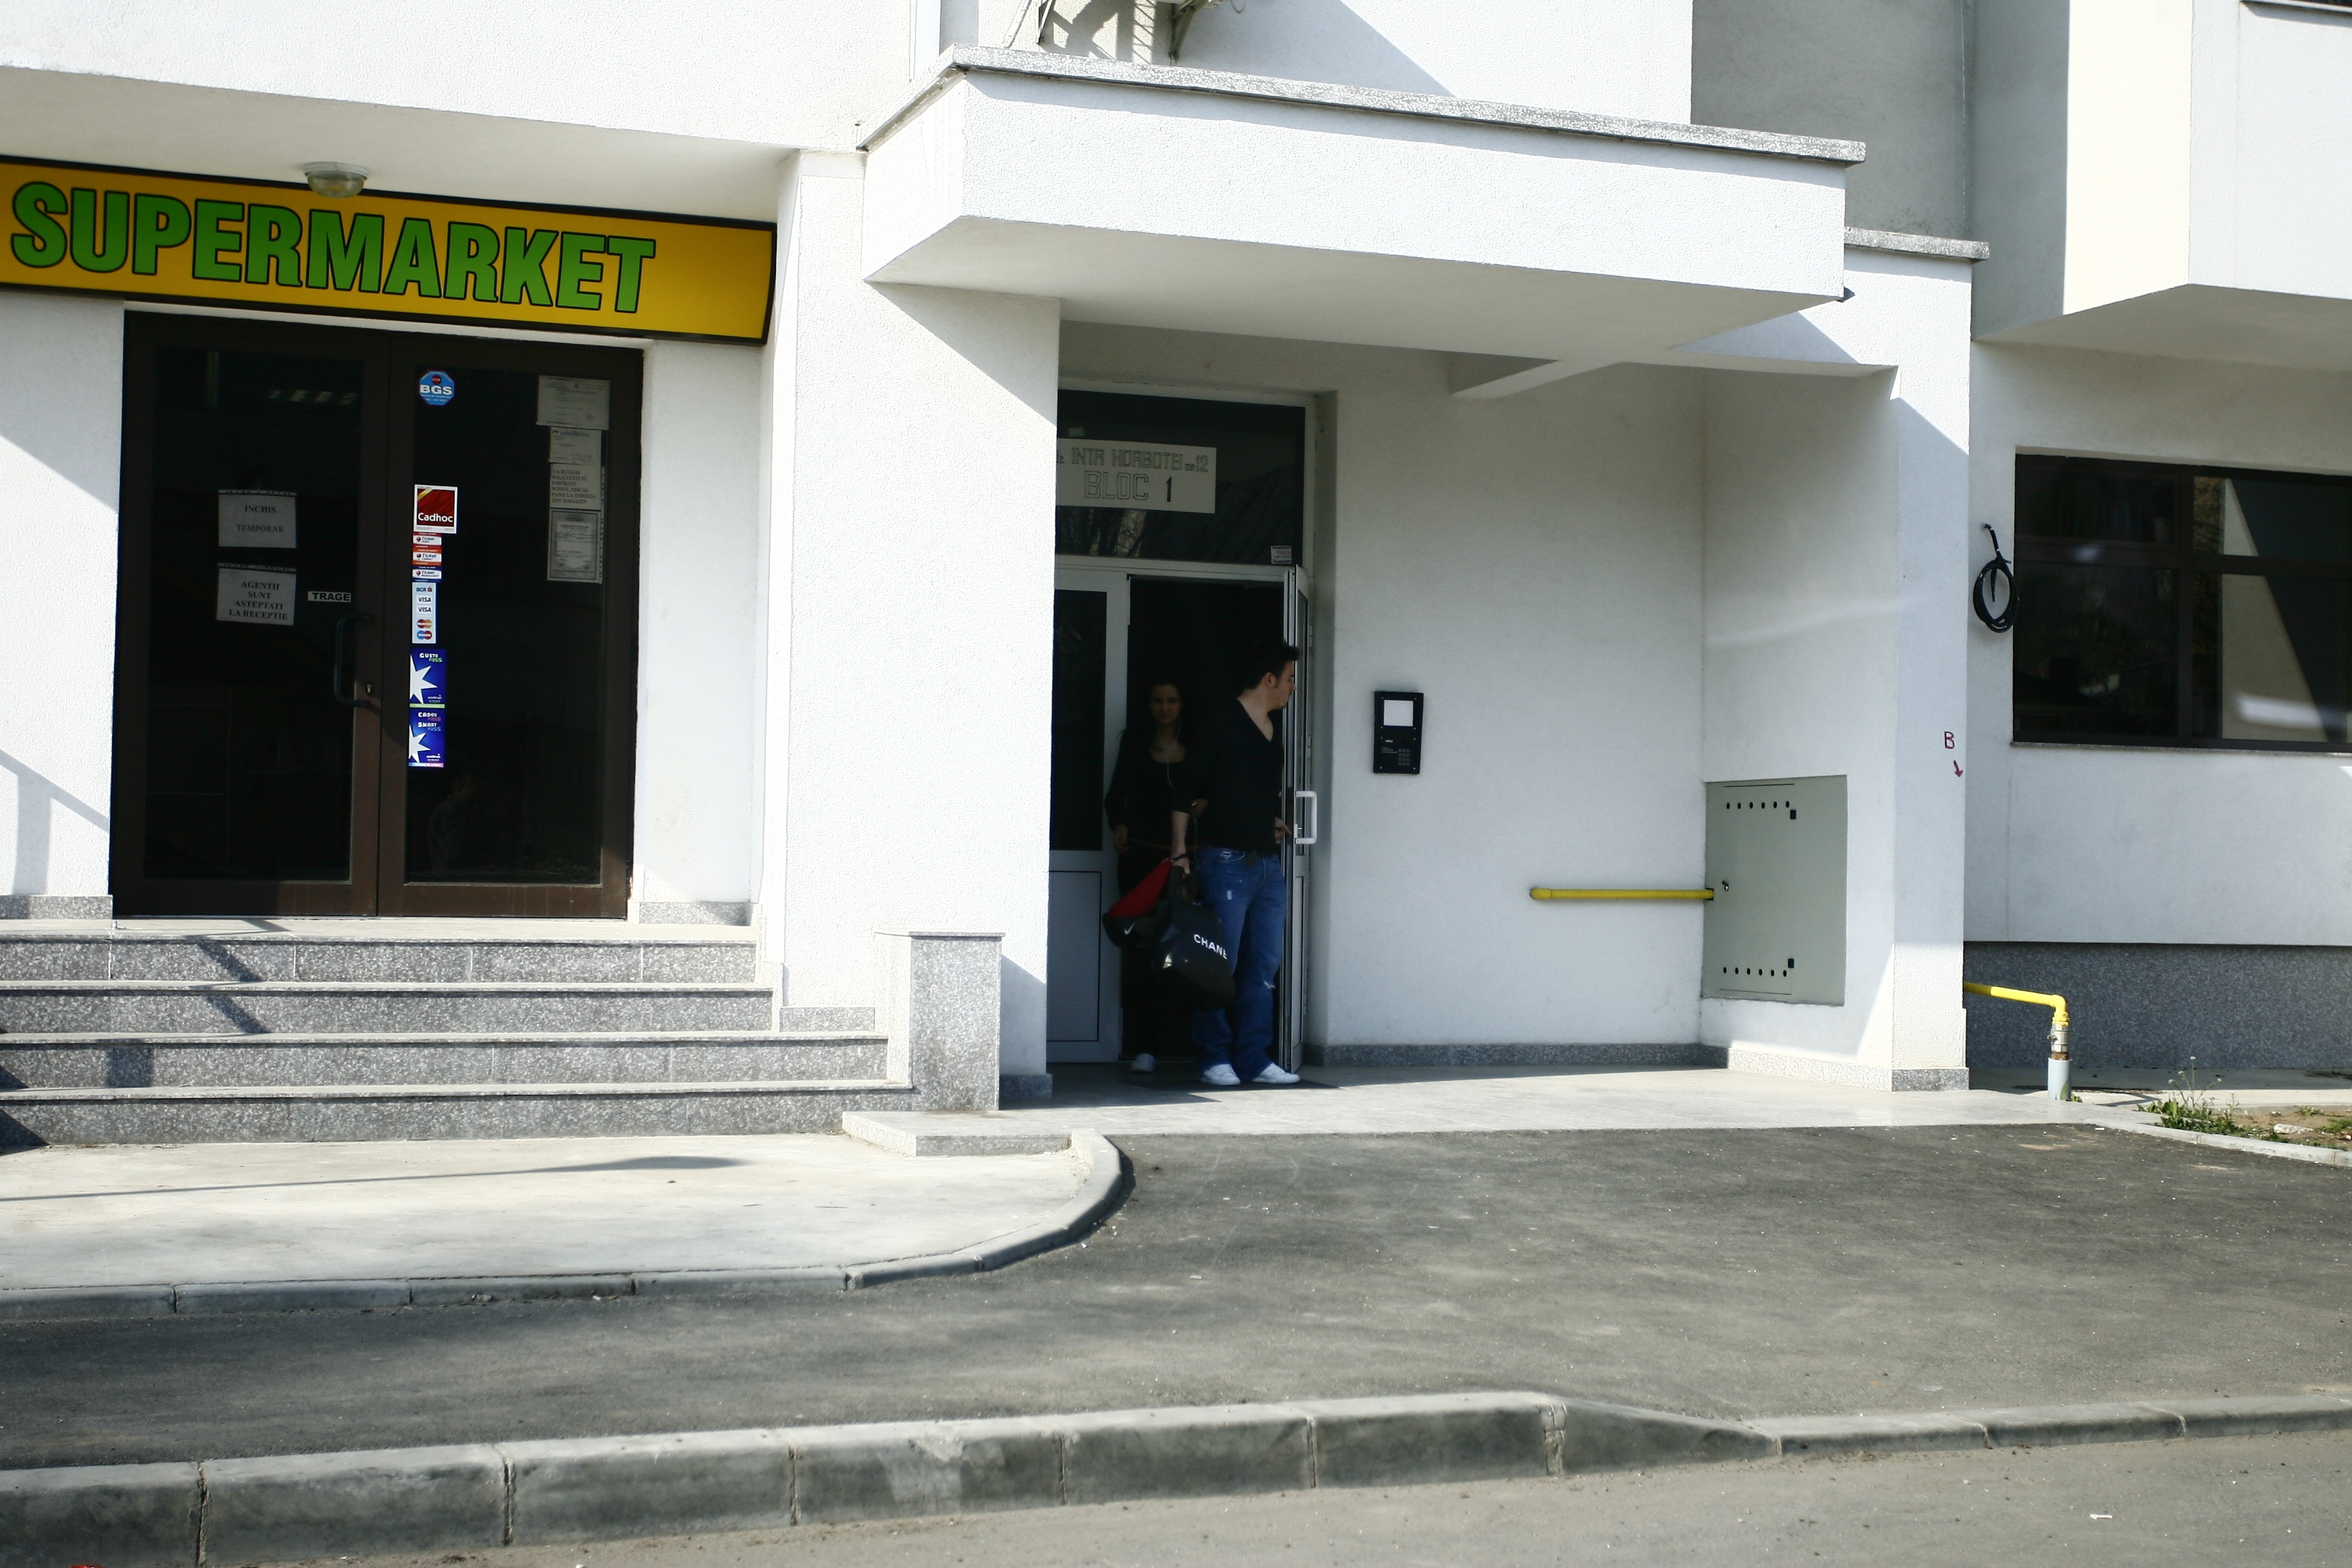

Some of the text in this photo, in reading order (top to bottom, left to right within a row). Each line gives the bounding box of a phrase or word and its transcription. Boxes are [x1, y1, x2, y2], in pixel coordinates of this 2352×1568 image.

[11, 181, 656, 314] SUPERMARKET
[420, 384, 453, 395] BGS
[1071, 447, 1105, 465] INTR
[1112, 449, 1183, 471] HORBOTEI
[1085, 470, 1172, 502] BLOC 1
[418, 512, 453, 522] Cadhoc
[237, 524, 284, 532] TEMPORAR
[241, 581, 279, 591] AGENTII
[248, 591, 272, 599] SUNT
[312, 592, 350, 601] TRAGE
[235, 601, 283, 610] ASTEPTATI
[243, 610, 288, 620] RECEPTIE
[1944, 731, 1955, 749] B
